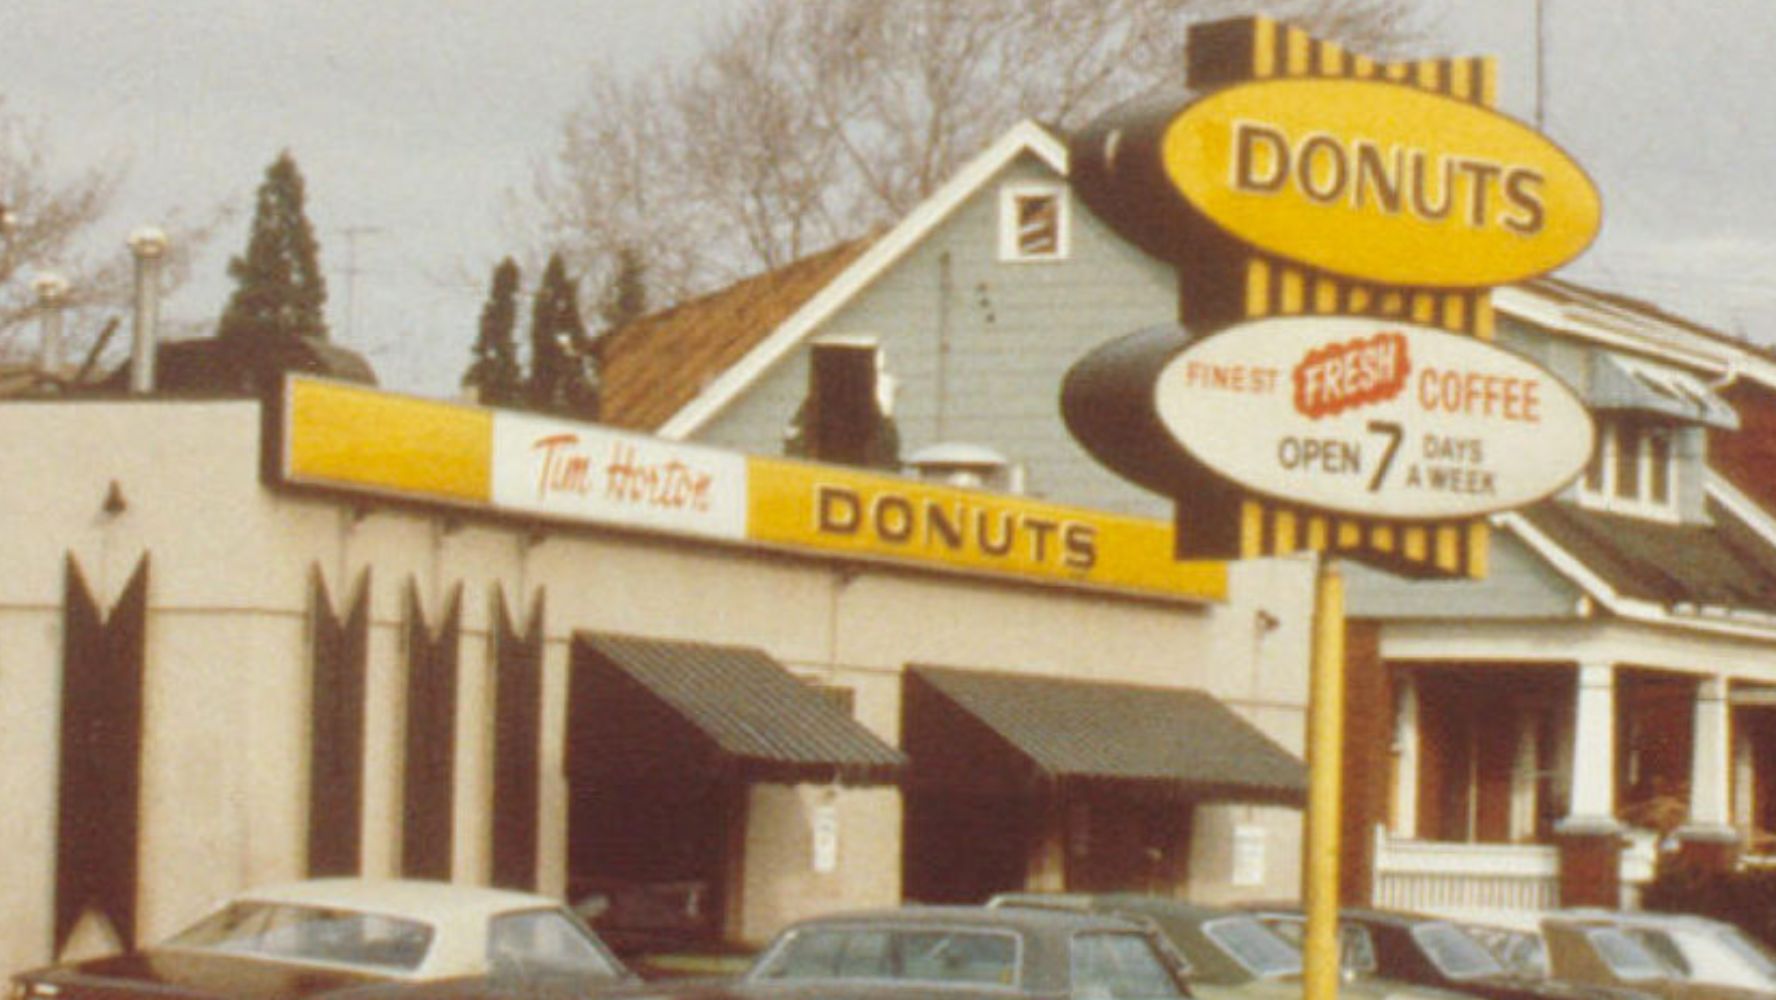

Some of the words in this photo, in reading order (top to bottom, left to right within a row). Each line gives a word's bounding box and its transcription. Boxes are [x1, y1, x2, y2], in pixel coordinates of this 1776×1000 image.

[1232, 119, 1547, 236] DONUTS
[1186, 360, 1279, 393] FINEST
[1303, 337, 1398, 408] FRESH
[1417, 366, 1541, 424] COFFEE
[1277, 436, 1361, 473] OPEN
[1366, 420, 1405, 492] 7
[1422, 433, 1484, 464] DAYS
[1406, 463, 1421, 487] A
[1427, 466, 1496, 495] WEEK
[532, 433, 593, 500] Tim
[606, 439, 713, 514] Horton
[816, 483, 1099, 571] DONUTS
